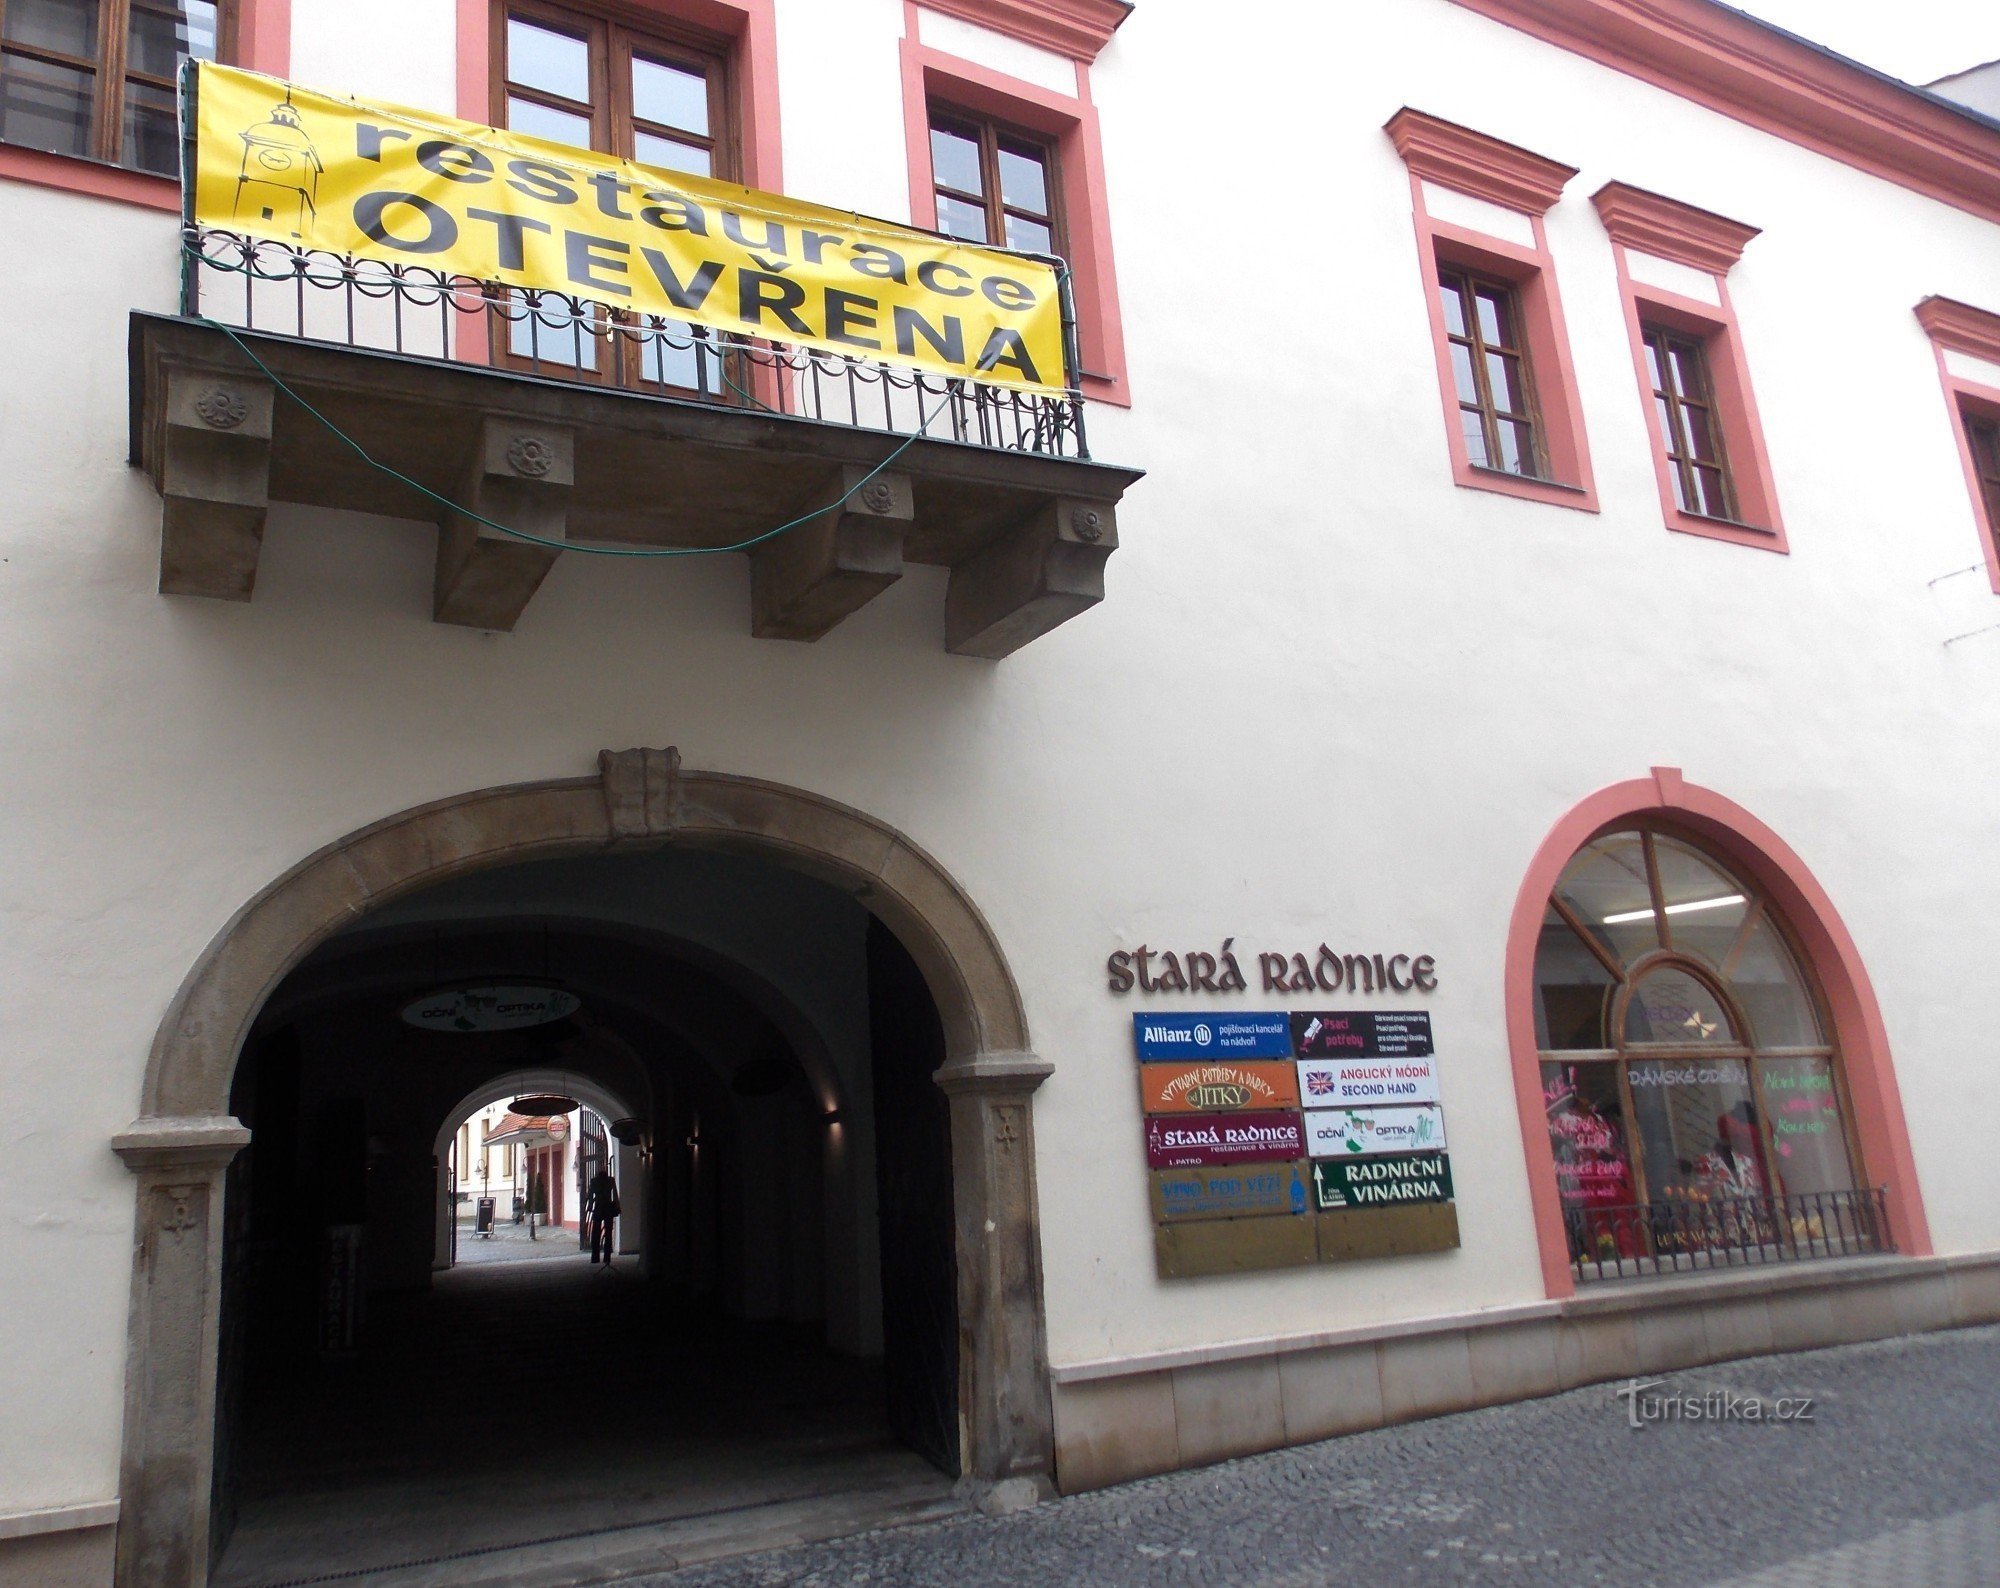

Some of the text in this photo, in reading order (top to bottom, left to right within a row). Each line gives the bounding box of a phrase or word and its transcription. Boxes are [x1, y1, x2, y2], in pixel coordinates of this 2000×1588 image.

[349, 115, 1038, 312] restaurace
[352, 190, 1039, 384] OTEVŘENA
[497, 1003, 546, 1014] OPTIKA
[1255, 1024, 1283, 1035] kancelář
[1323, 1018, 1349, 1030] Psací
[1144, 1026, 1192, 1043] Allianz
[1221, 1036, 1256, 1047] na nádvoří
[1325, 1034, 1364, 1048] potřeby
[1238, 1070, 1245, 1085] A
[1340, 1062, 1430, 1080] ANGLICKÝ MÓDNÍ
[1341, 1083, 1416, 1096] SECOND HAND
[1198, 1086, 1244, 1110] JITKY
[1317, 1125, 1416, 1139] OČNÍ OPTIKA
[1211, 1144, 1256, 1153] restaurace
[1268, 1141, 1299, 1150] vinárna
[1345, 1155, 1443, 1182] RADNIČNÍ
[1352, 1179, 1442, 1203] VINÁRNA
